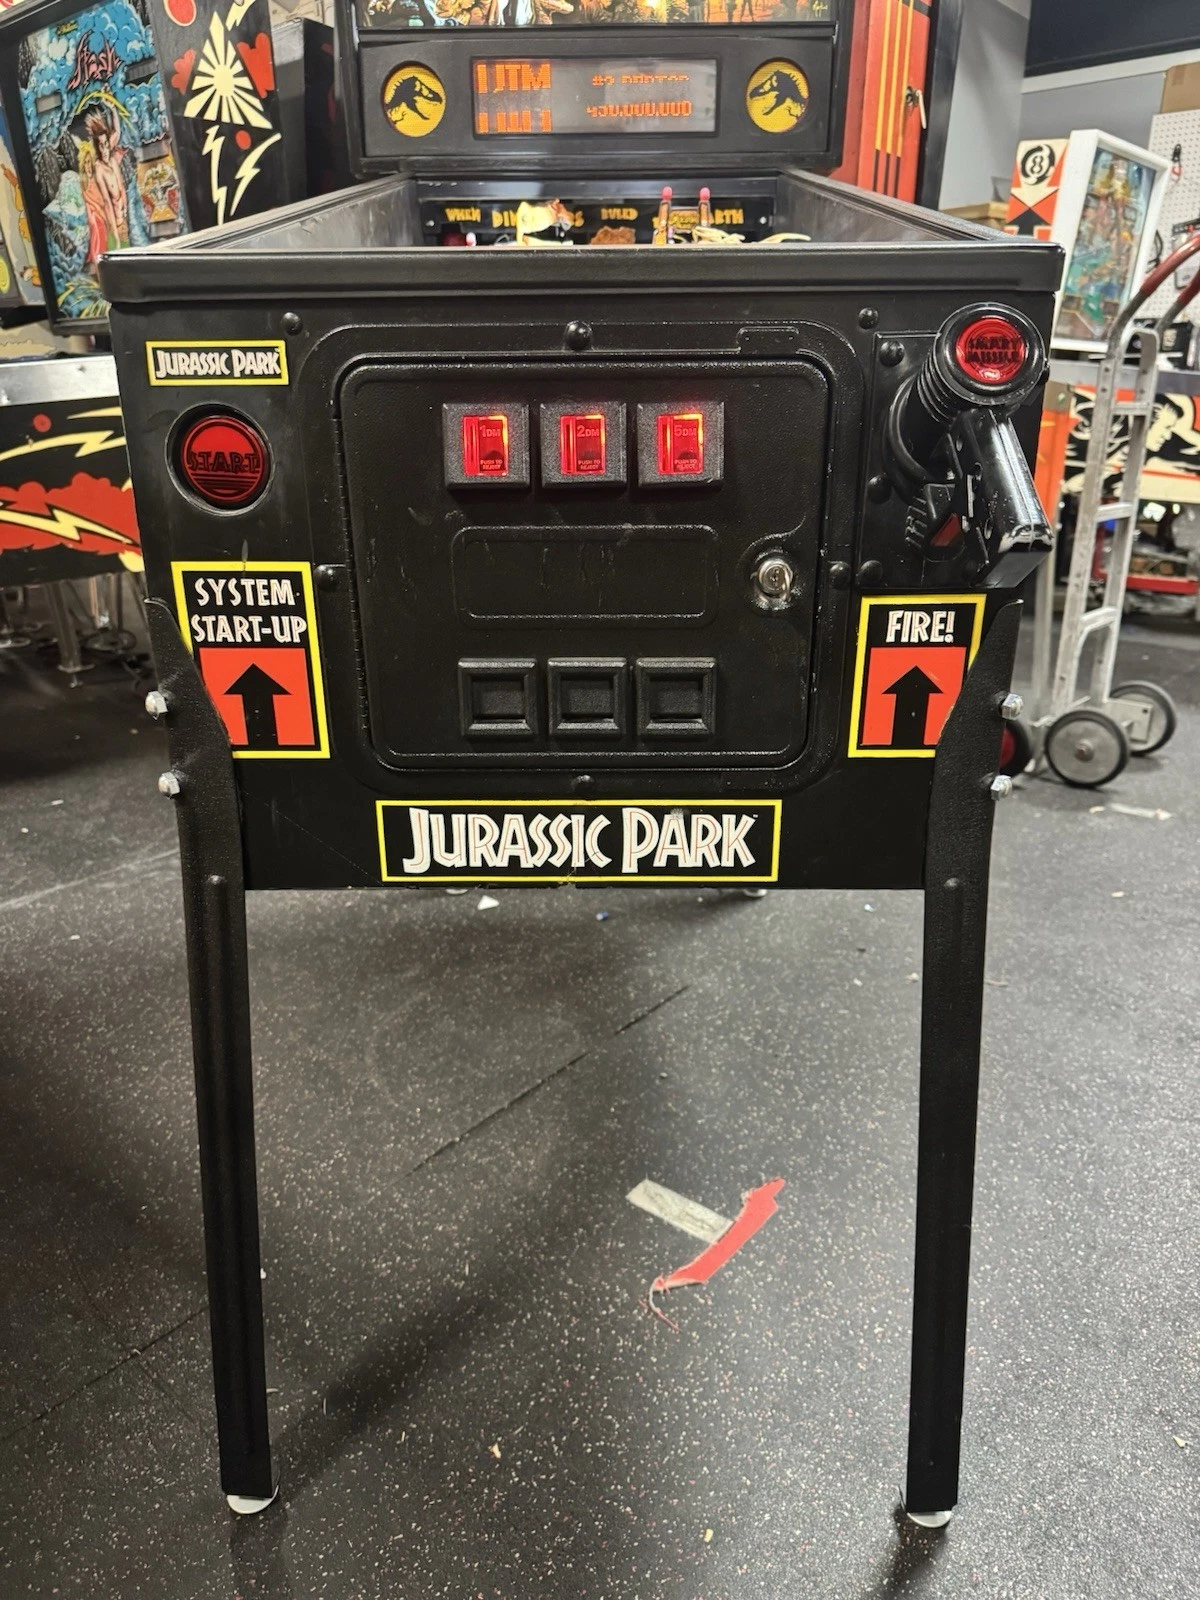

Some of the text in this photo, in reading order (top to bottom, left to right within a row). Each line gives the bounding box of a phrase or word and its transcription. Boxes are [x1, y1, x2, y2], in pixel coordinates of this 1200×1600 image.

[156, 349, 282, 379] JURASSIC PARK
[188, 451, 260, 474] START
[194, 577, 296, 607] SYSTEM
[190, 613, 307, 643] START-UP
[885, 610, 955, 643] FIRE!
[402, 807, 757, 874] JURASSIC PARK
